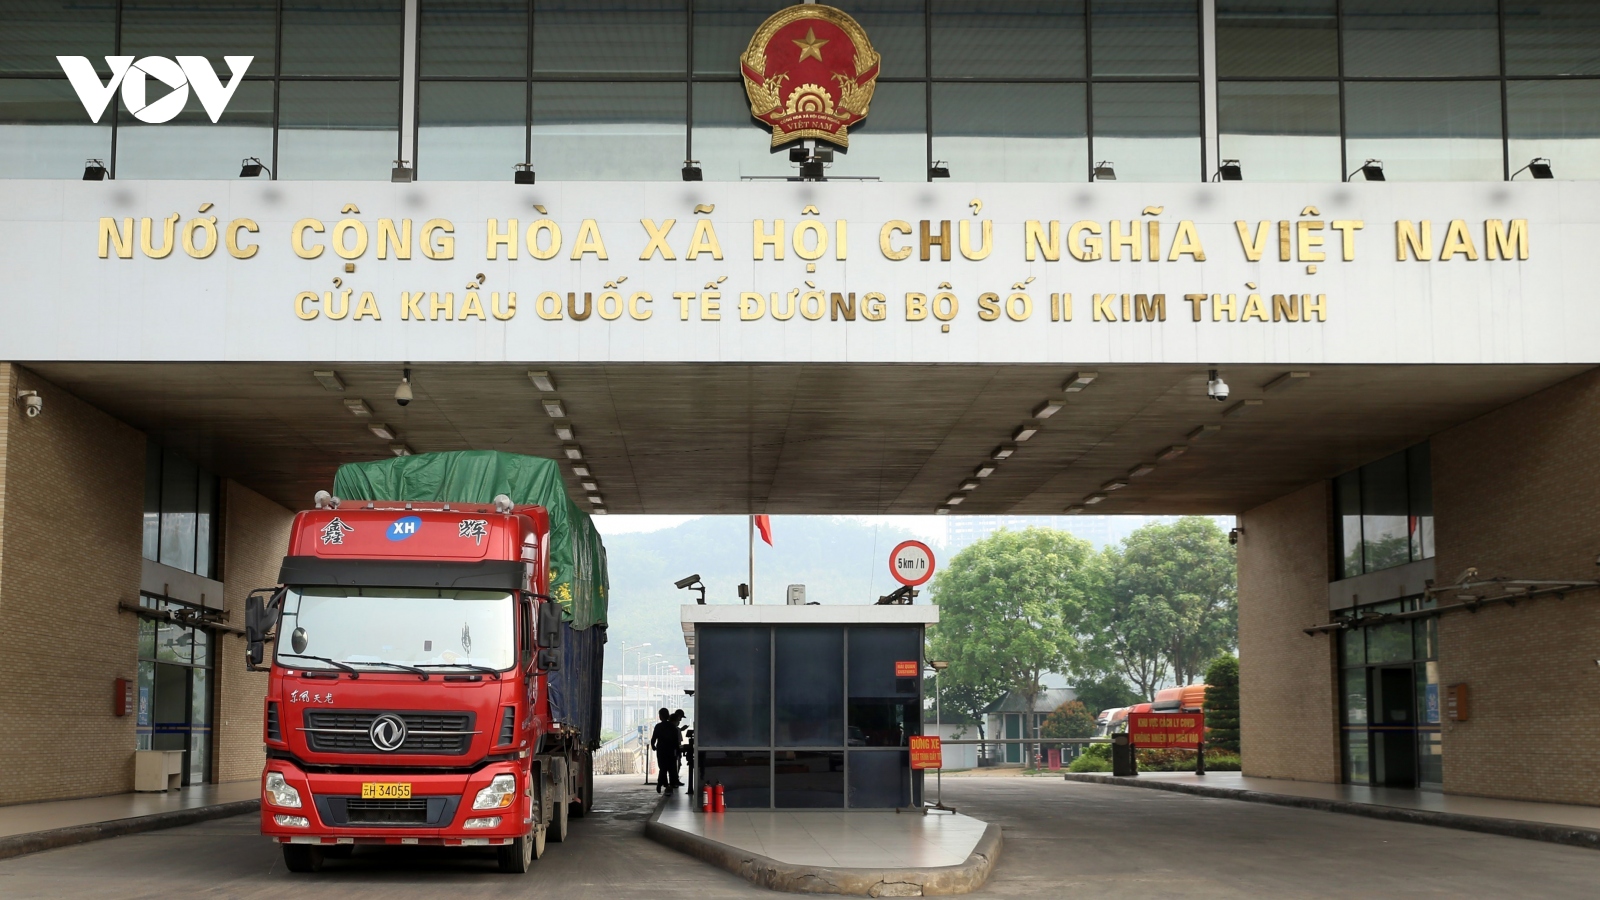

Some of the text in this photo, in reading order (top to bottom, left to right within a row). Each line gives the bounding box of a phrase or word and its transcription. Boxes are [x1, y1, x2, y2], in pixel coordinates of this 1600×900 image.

[812, 121, 833, 130] NAM
[98, 198, 1530, 275] NƯỚC CỘNG HÒA XÃ HỘI CHỦ NGHĨA VIỆT NAM
[294, 273, 1328, 334] CỬA KHẨU QUỐC TẾ ĐƯỜNG BỘ SỐ II KIM THÀNH
[393, 522, 415, 534] XH
[931, 738, 940, 749] XE
